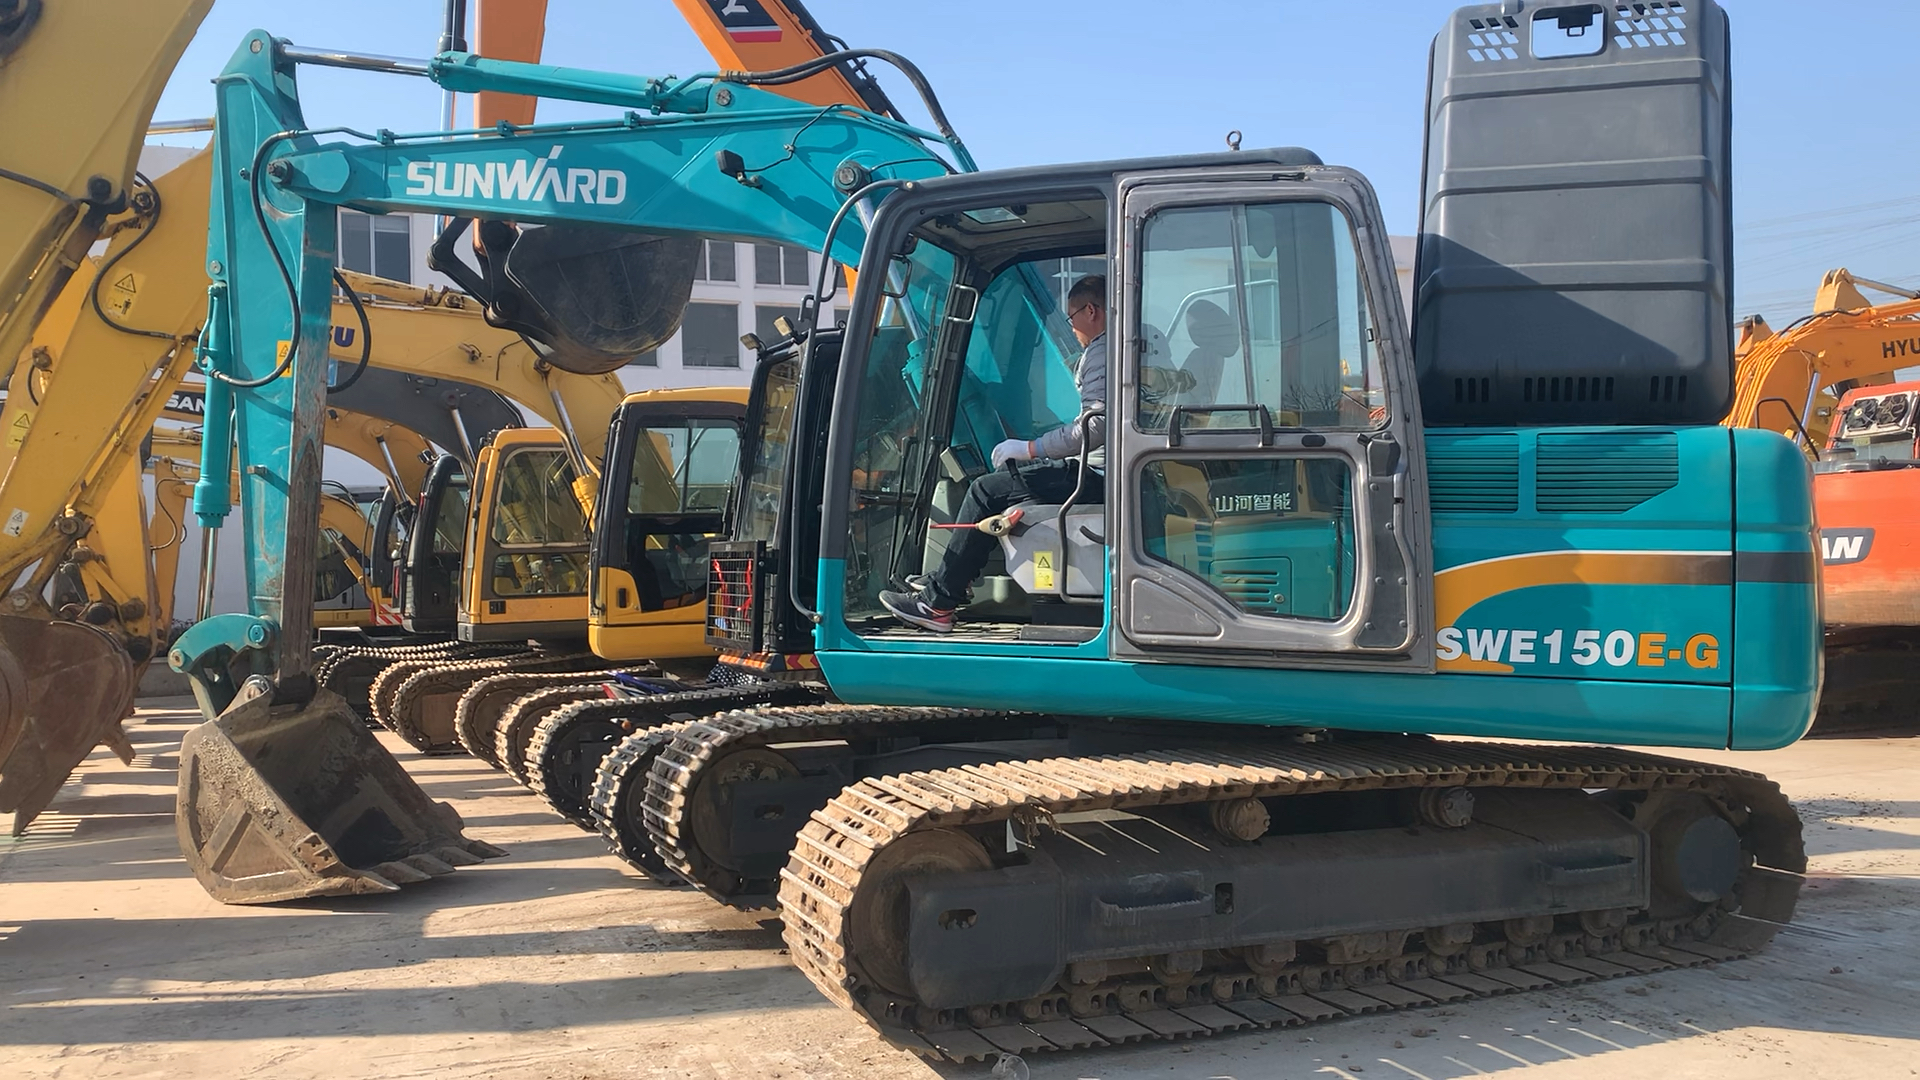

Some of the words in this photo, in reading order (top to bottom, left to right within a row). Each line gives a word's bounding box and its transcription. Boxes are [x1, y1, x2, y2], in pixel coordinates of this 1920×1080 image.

[406, 145, 627, 205] SUNWARD
[329, 325, 355, 347] U
[1215, 492, 1291, 512] 山河智能
[1436, 627, 1719, 669] SWE150E-G
